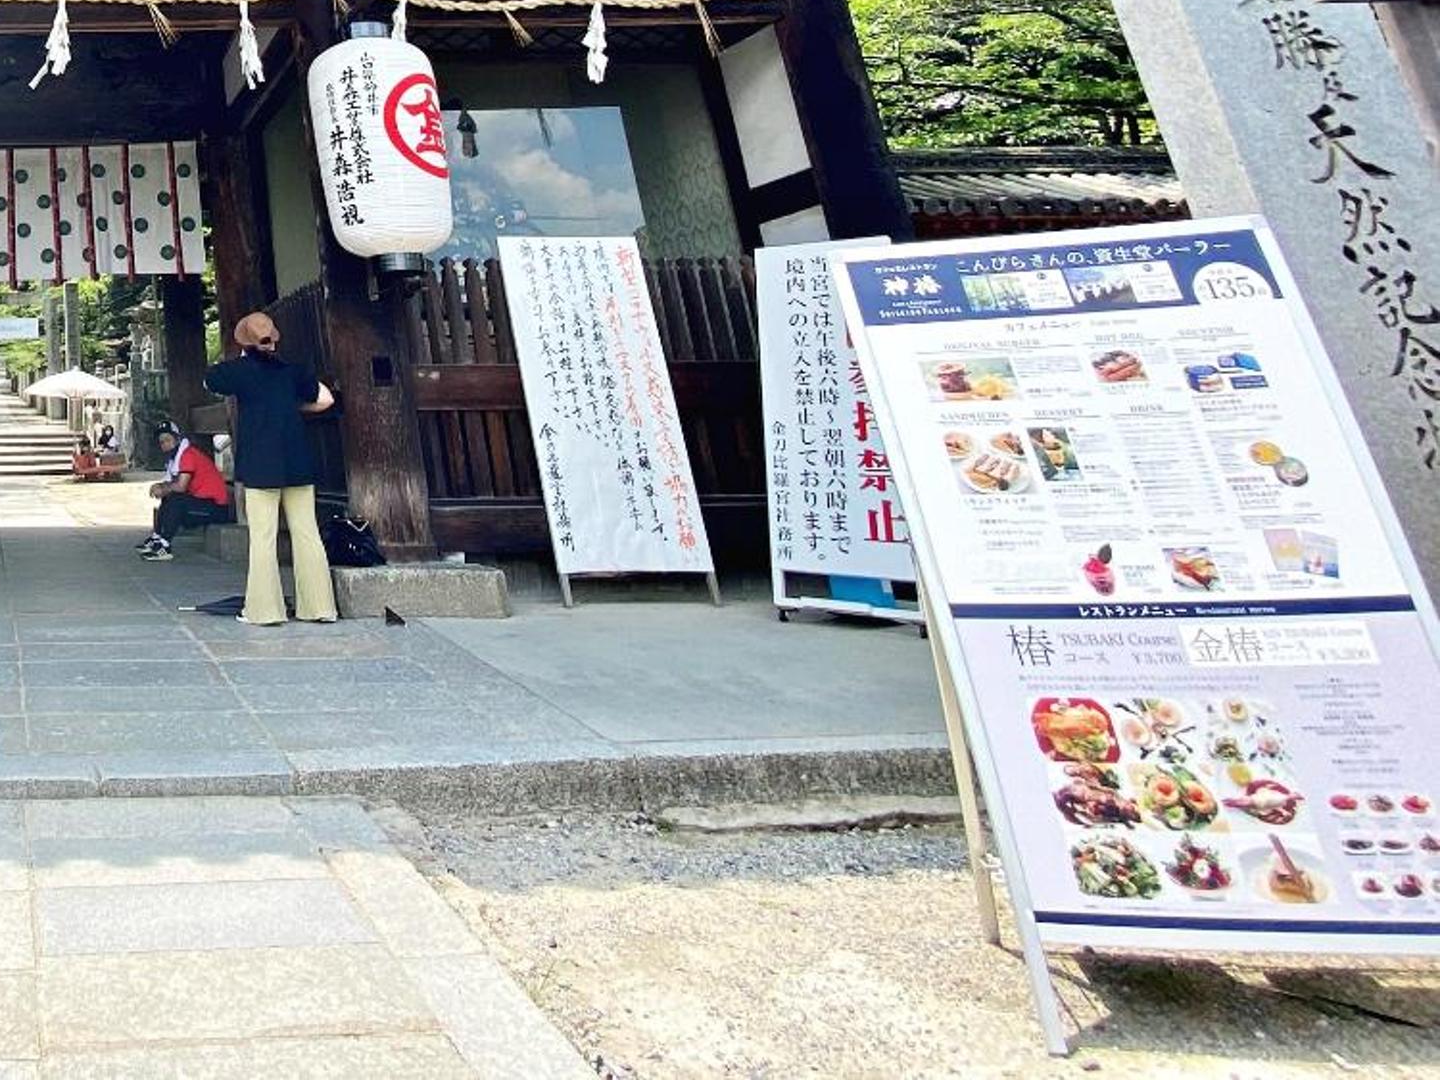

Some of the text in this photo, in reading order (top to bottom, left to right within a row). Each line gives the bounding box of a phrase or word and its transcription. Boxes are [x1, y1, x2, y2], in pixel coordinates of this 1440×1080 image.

[1078, 604, 1188, 617] レストランメニュー
[1005, 624, 1177, 667] 椿 TSUBAKI Course
[1190, 626, 1264, 664] 金椿
